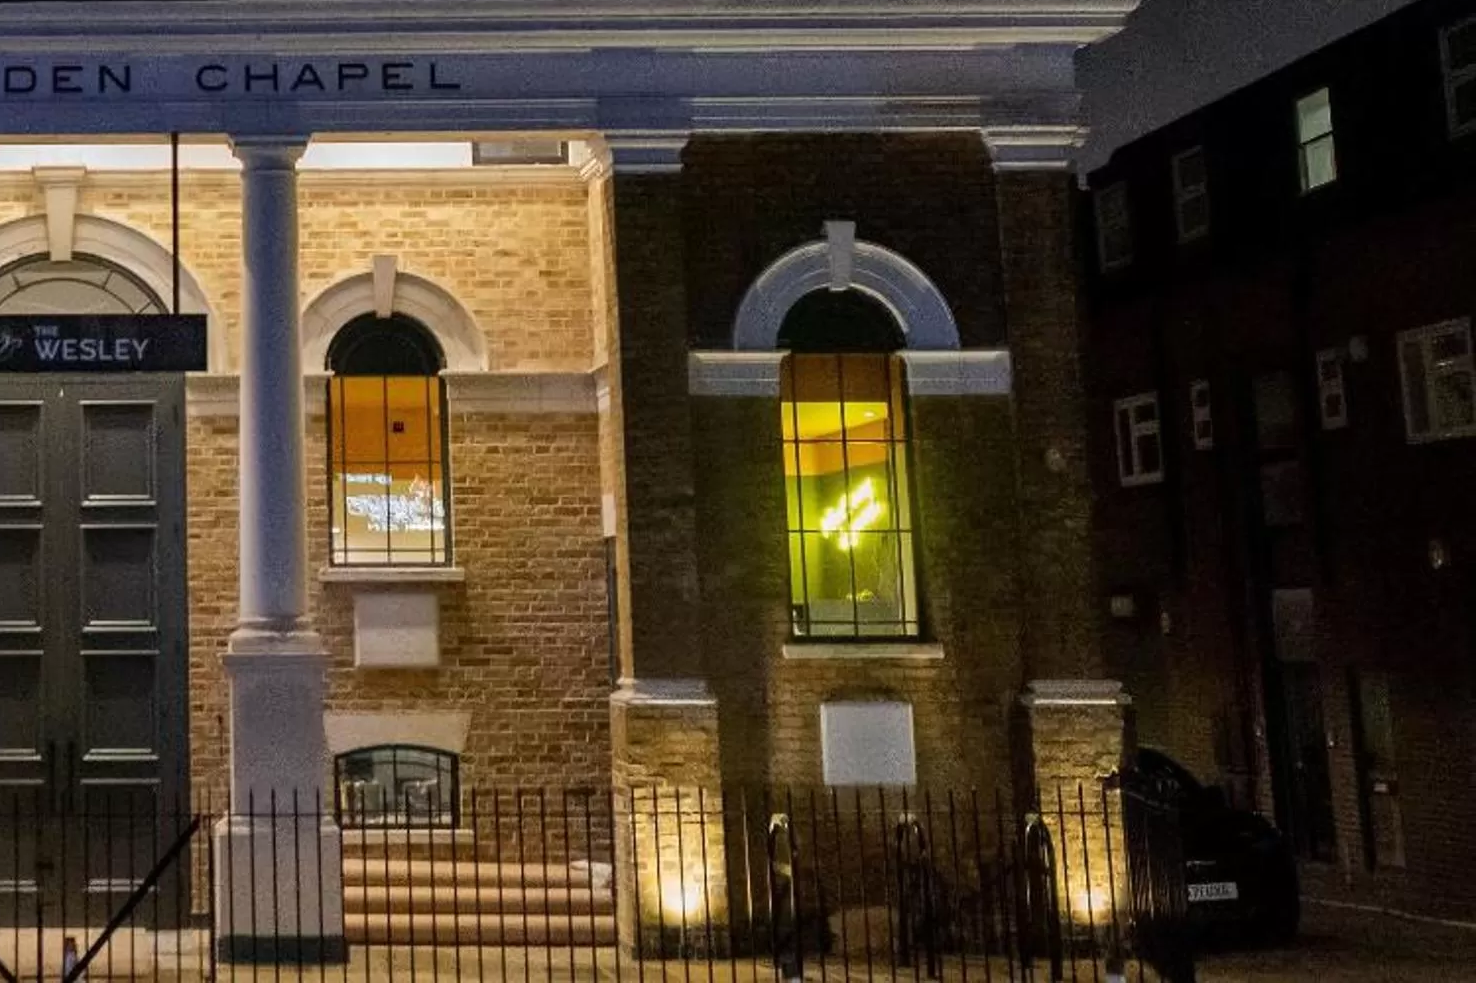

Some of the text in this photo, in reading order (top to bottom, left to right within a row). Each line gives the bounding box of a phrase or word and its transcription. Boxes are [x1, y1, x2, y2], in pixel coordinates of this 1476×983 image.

[196, 63, 462, 92] CHAPEL
[34, 325, 59, 336] THE
[34, 339, 149, 361] WESLEY
